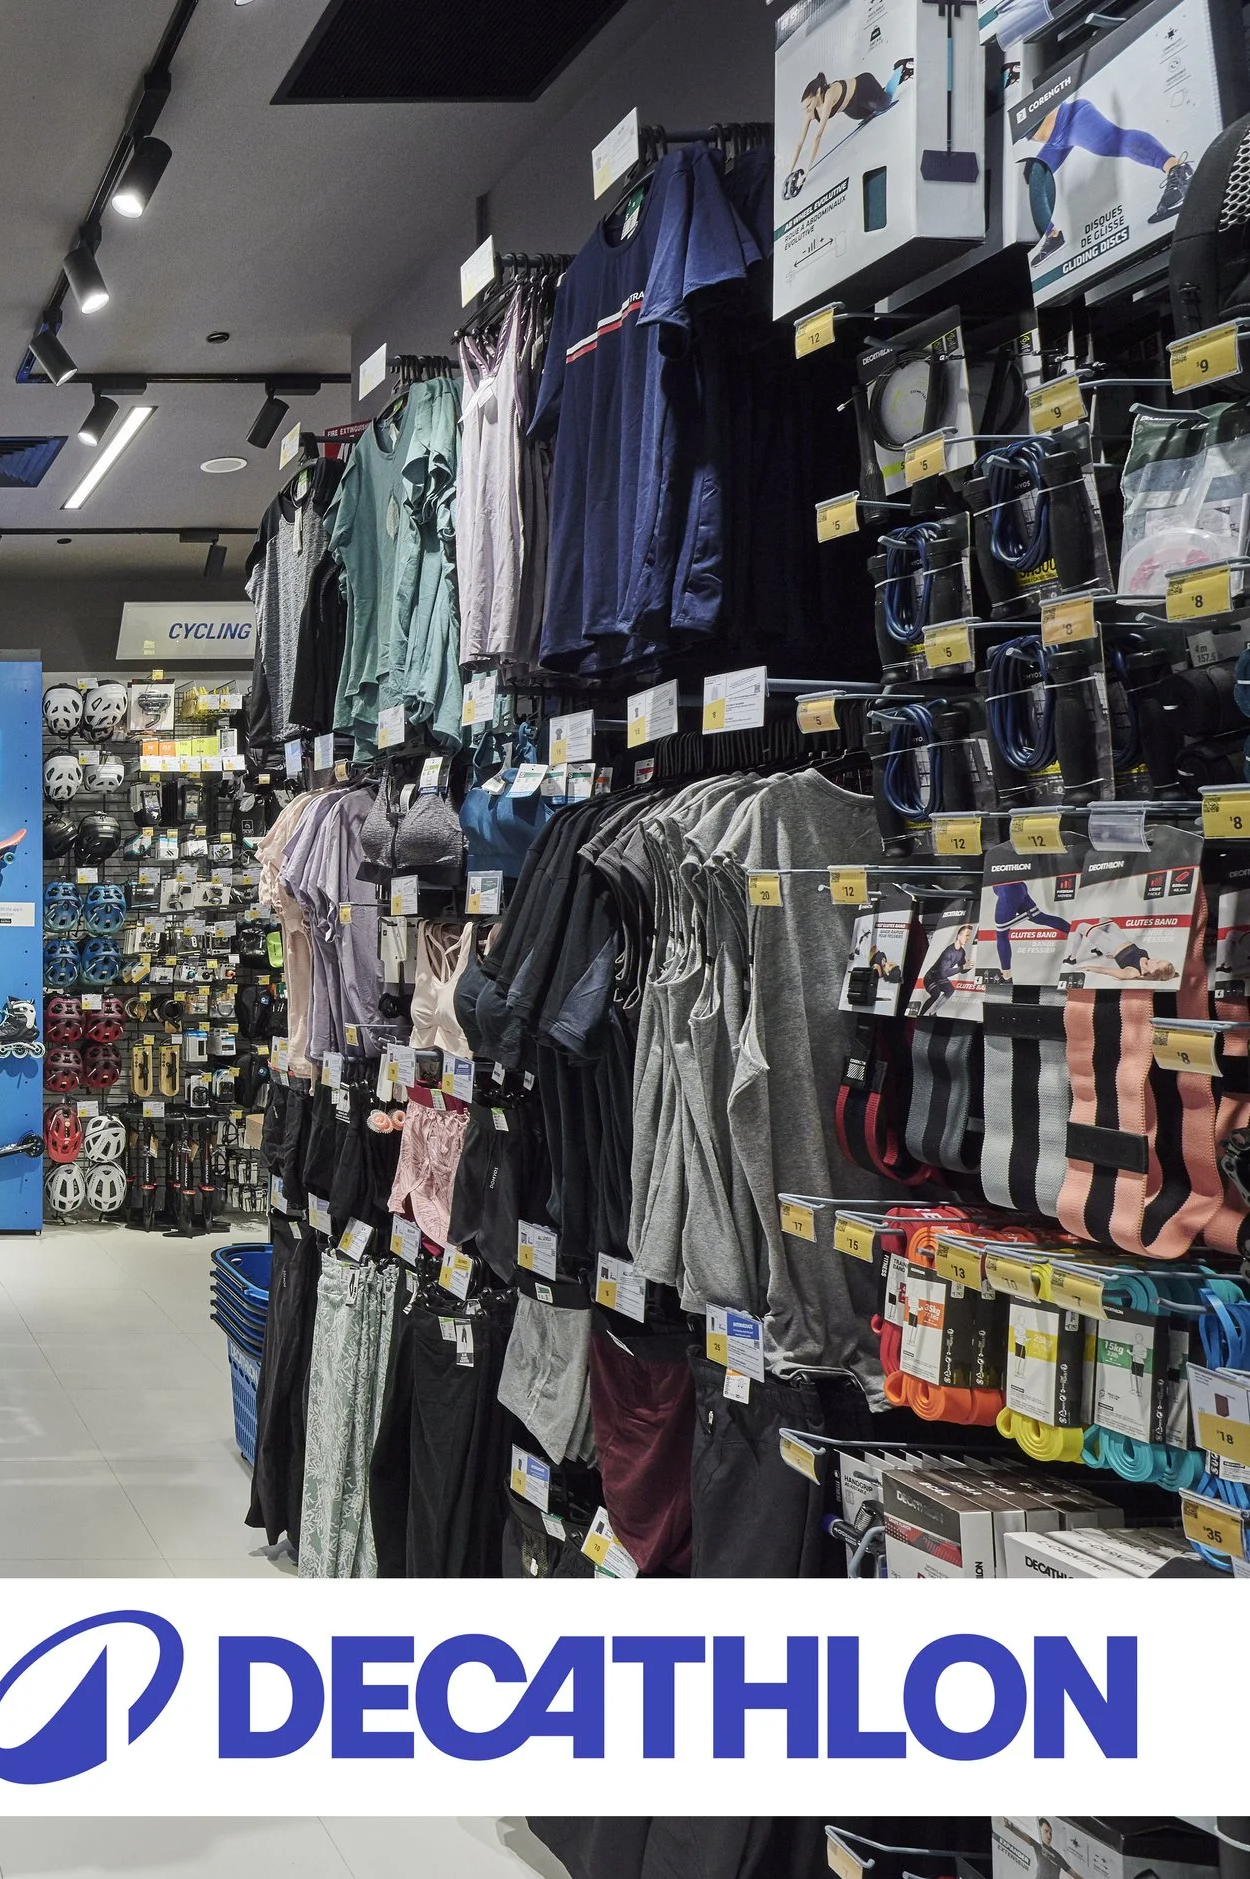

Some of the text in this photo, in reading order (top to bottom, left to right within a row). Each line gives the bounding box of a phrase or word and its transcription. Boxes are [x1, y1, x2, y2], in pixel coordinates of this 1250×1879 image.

[1029, 77, 1072, 113] CORENGTH
[813, 182, 848, 209] EVOLUTIVE
[806, 195, 846, 228] ABDOMINAUX
[1084, 204, 1124, 234] DISQUES
[785, 225, 815, 250] EVOLUTIVE
[1081, 216, 1125, 248] DE GLISSE
[1062, 230, 1128, 274] GLIDING DISCS
[1196, 358, 1209, 373] $9
[327, 429, 338, 437] FIRE
[1191, 594, 1204, 608] $8
[168, 623, 252, 640] CYCLING
[991, 862, 1031, 873] DECATHLON
[1088, 860, 1124, 872] DECATHLON
[1125, 917, 1178, 927] GLUTES BAND
[1010, 931, 1057, 939] GLUTES BAND
[1104, 1340, 1124, 1355] 15kg
[1203, 1526, 1222, 1544] $35
[1025, 1555, 1074, 1578] DECATH
